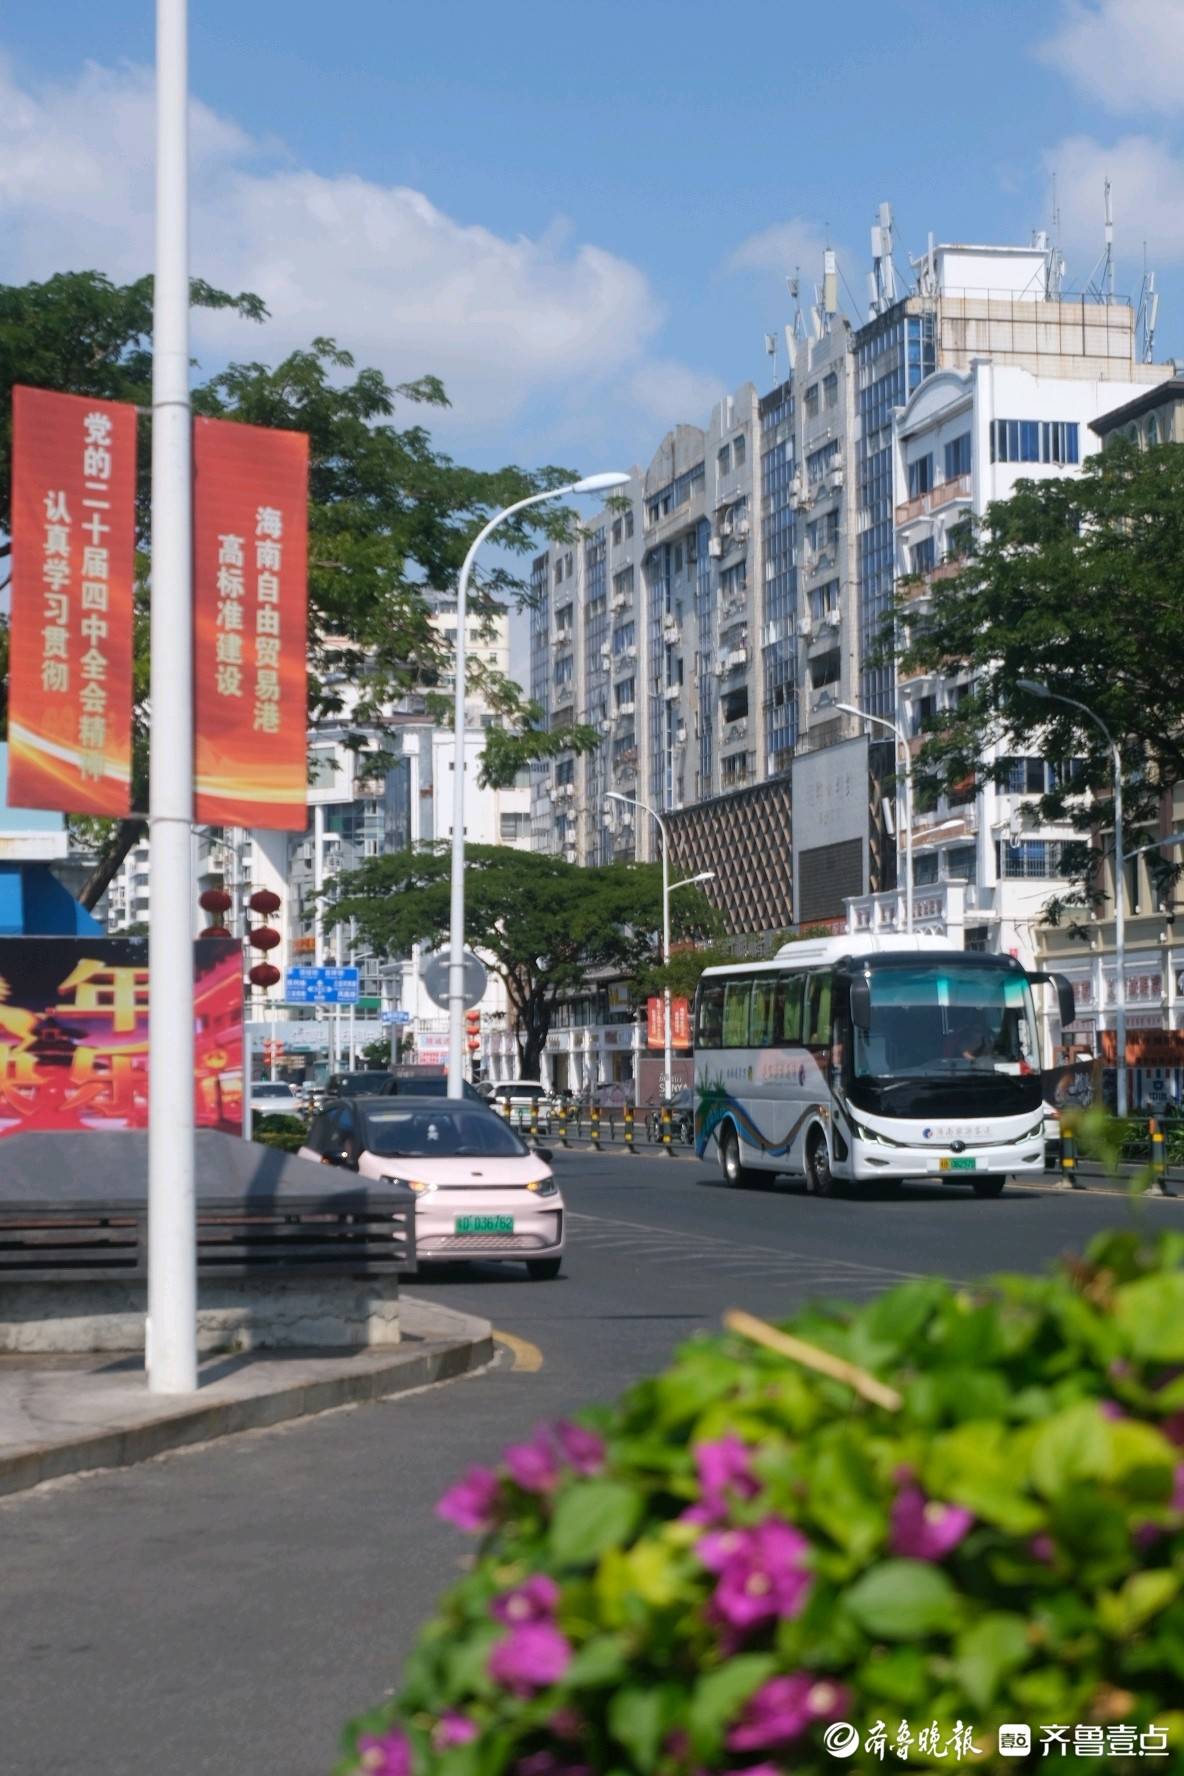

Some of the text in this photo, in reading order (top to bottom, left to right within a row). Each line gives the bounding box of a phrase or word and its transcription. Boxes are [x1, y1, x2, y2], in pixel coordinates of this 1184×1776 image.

[41, 490, 71, 693] 认真学习贯彻
[214, 534, 245, 698] 高标准建设
[253, 505, 284, 734] 海南自由贸易港
[659, 1083, 689, 1094] SNYA
